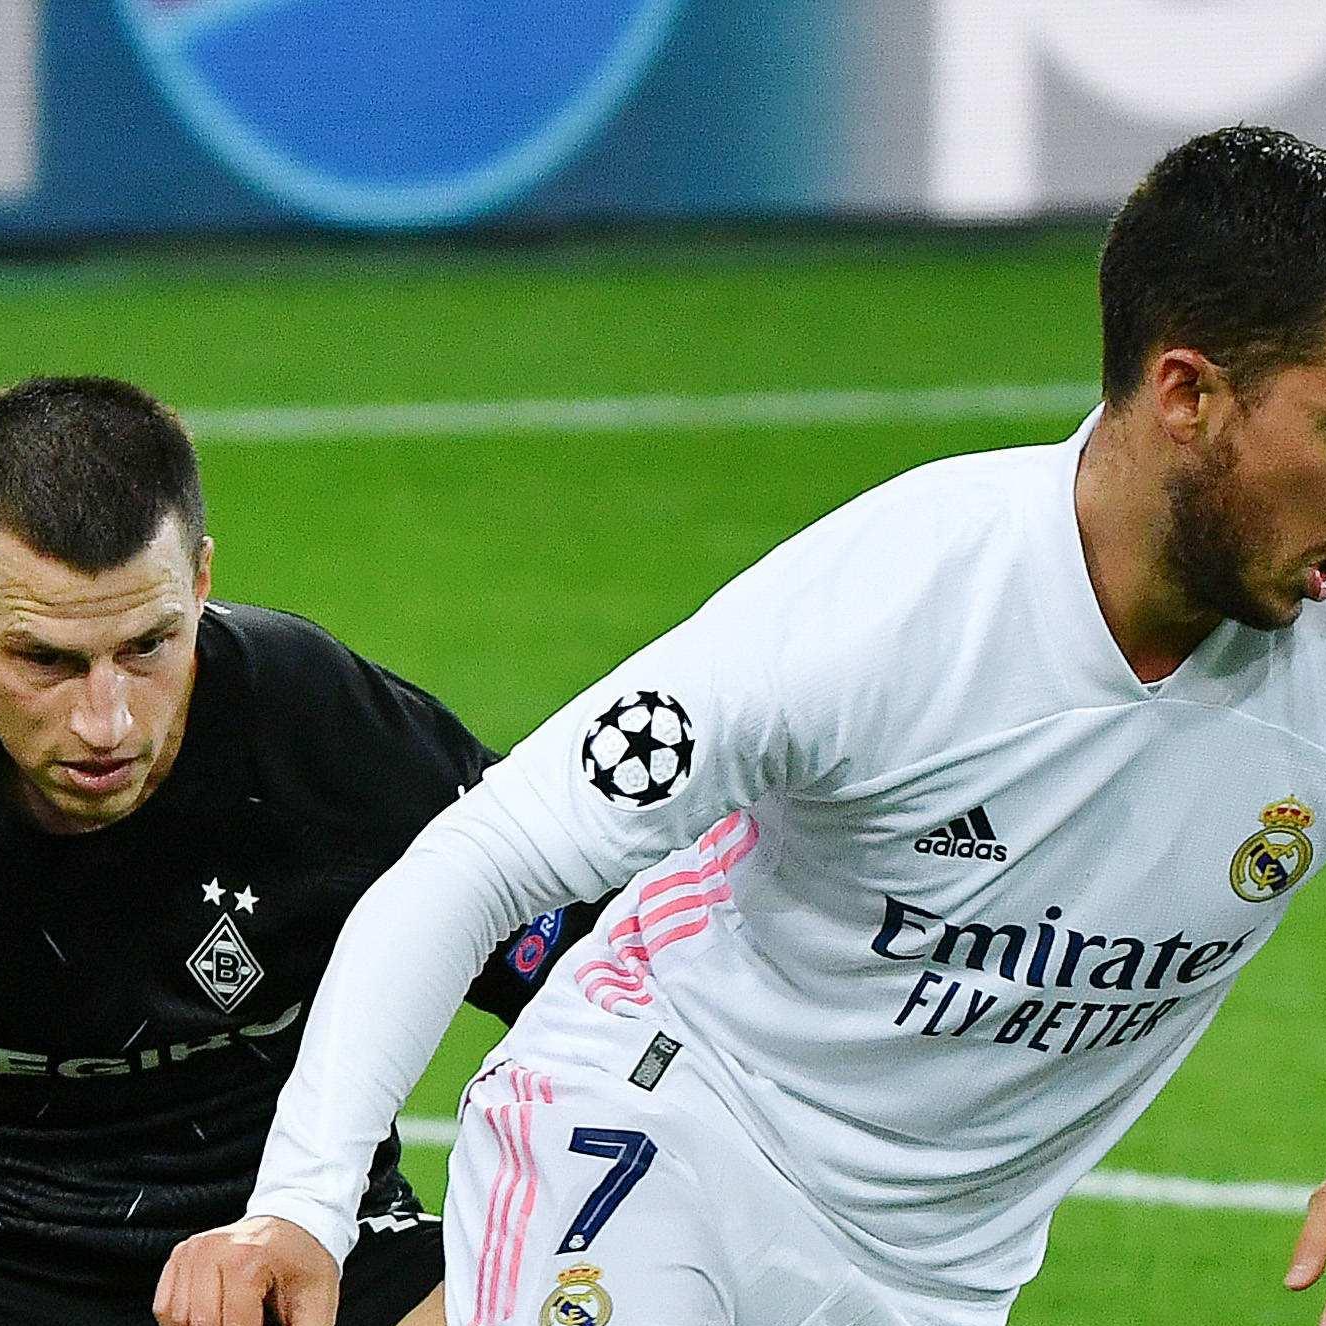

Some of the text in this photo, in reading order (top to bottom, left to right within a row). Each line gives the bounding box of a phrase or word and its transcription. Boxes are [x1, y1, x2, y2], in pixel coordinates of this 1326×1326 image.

[914, 836, 1008, 863] adidas
[894, 970, 1182, 1055] FLY BETTER
[555, 1126, 659, 1256] 7
